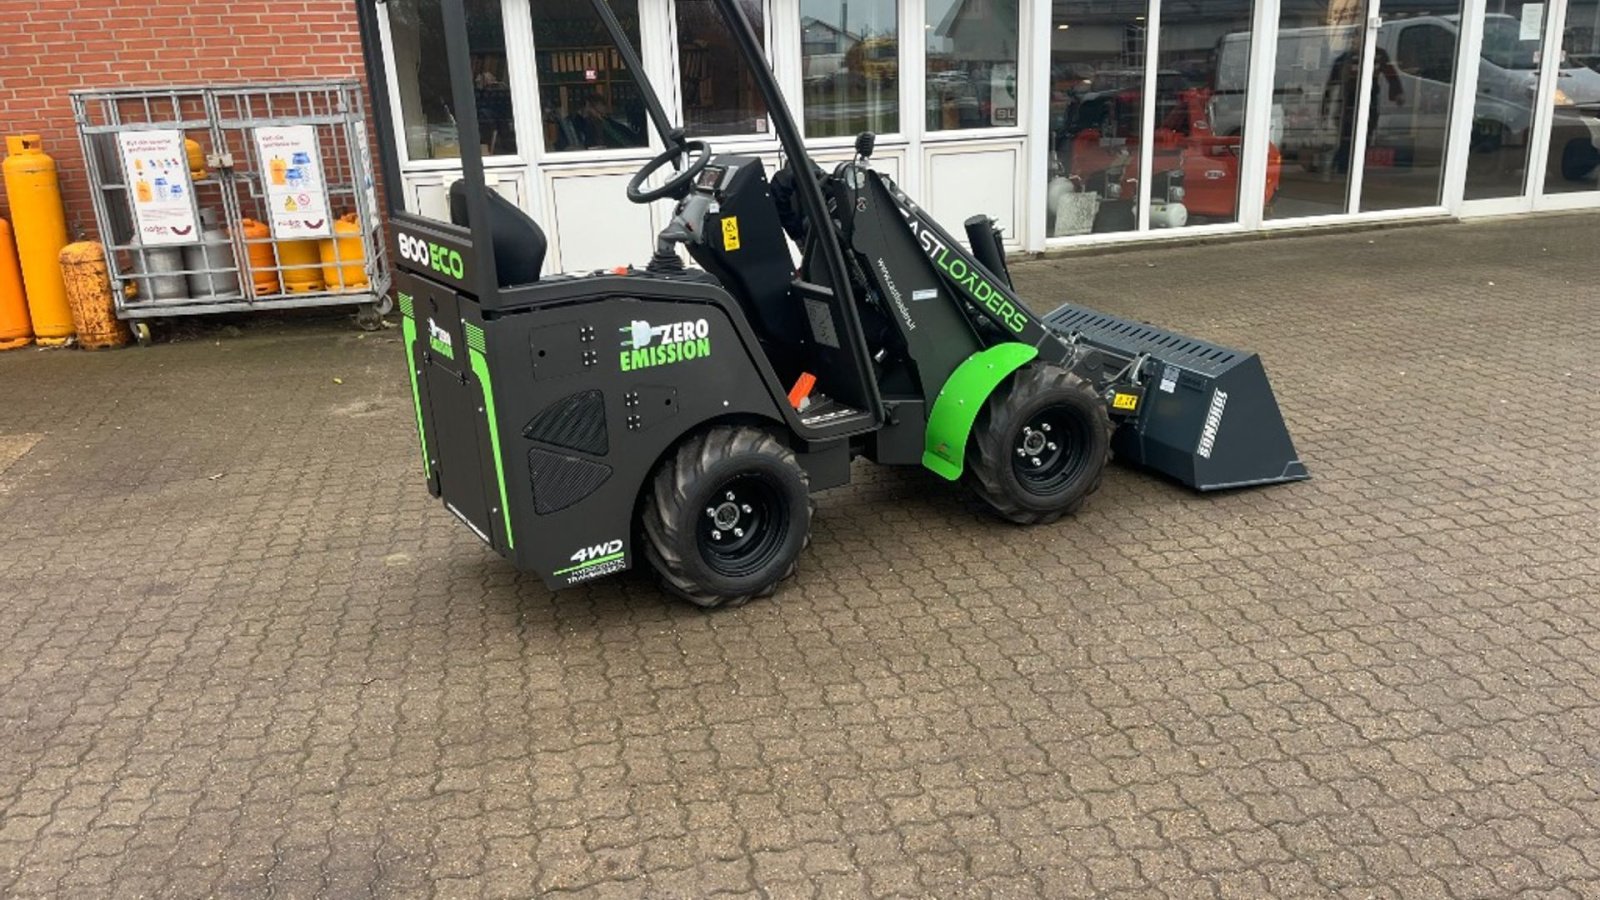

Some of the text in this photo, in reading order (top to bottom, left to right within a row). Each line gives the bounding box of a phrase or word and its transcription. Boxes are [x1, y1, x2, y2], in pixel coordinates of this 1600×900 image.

[660, 318, 709, 345] ZERO
[620, 337, 711, 372] EMISSION
[570, 539, 623, 562] 4WD
